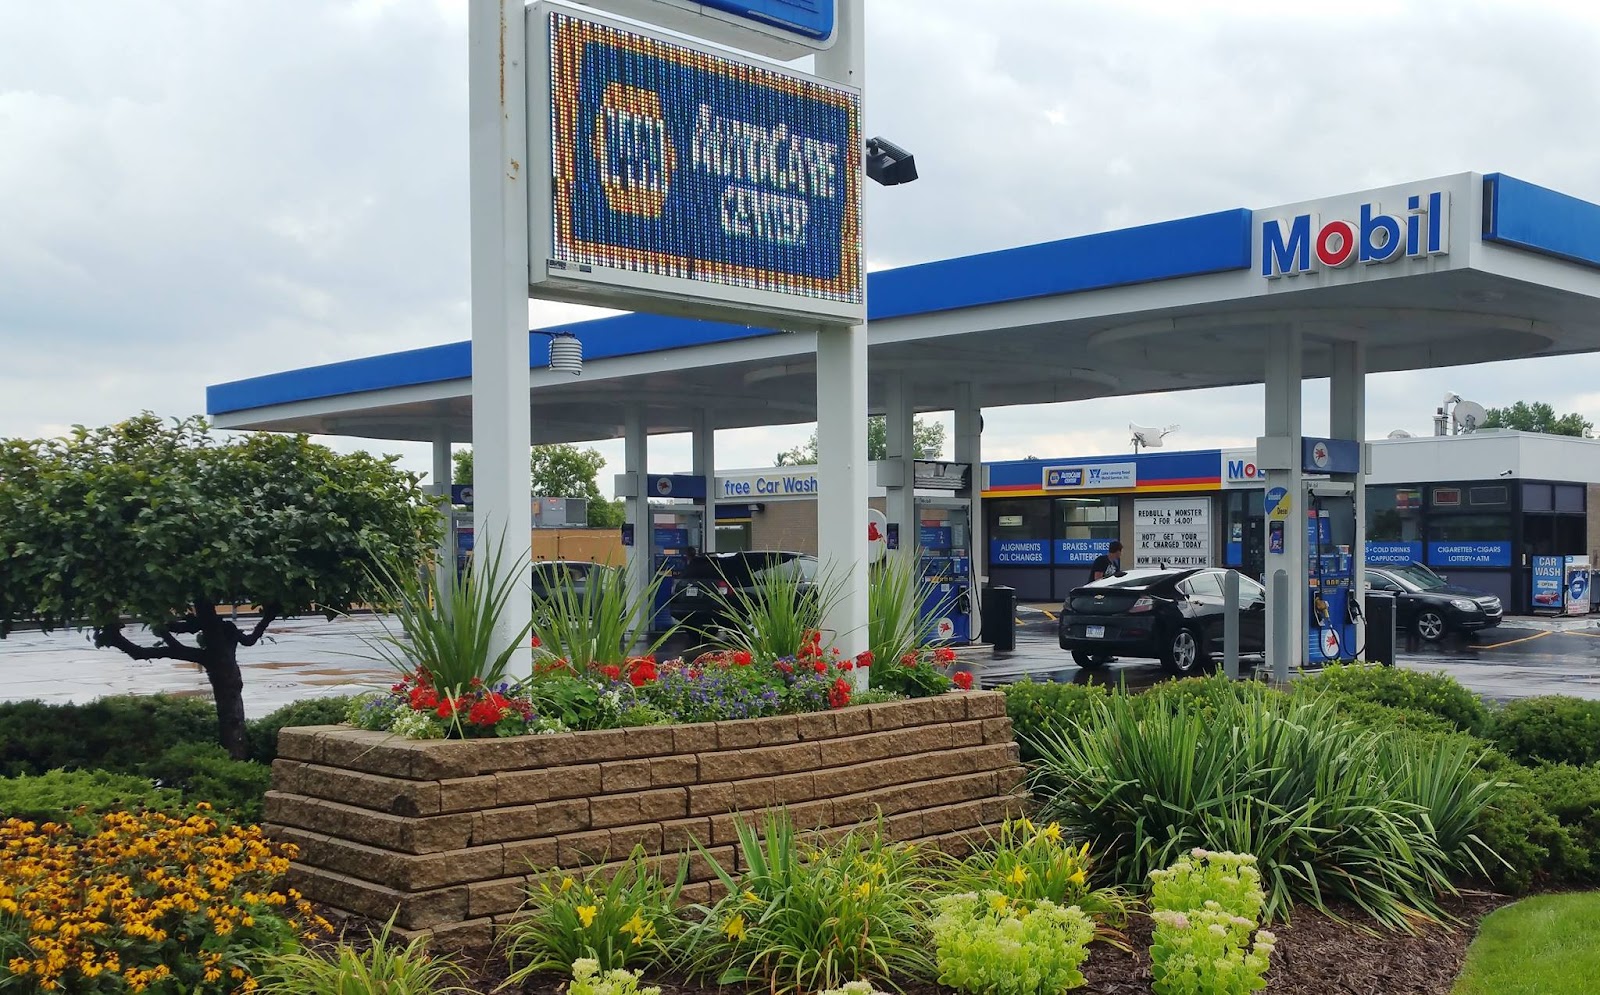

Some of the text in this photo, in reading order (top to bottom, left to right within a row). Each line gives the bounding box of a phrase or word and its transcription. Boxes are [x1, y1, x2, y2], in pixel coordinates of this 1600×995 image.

[1262, 191, 1450, 279] Mobil
[725, 476, 818, 495] free Car Wash
[1175, 508, 1202, 517] MONSTER
[1142, 533, 1197, 541] HOT? GET YOUR
[1000, 543, 1041, 552] ALIGNMENTS
[1062, 542, 1110, 551] BRAKES TIRES
[1153, 541, 1179, 549] CHARGED
[1182, 541, 1201, 549] TODAY
[998, 553, 1043, 562] OIL CHANGES
[1137, 556, 1150, 564] NOW
[1151, 556, 1171, 564] HIRING
[1539, 557, 1557, 566] CAR
[1535, 567, 1561, 577] WASH
